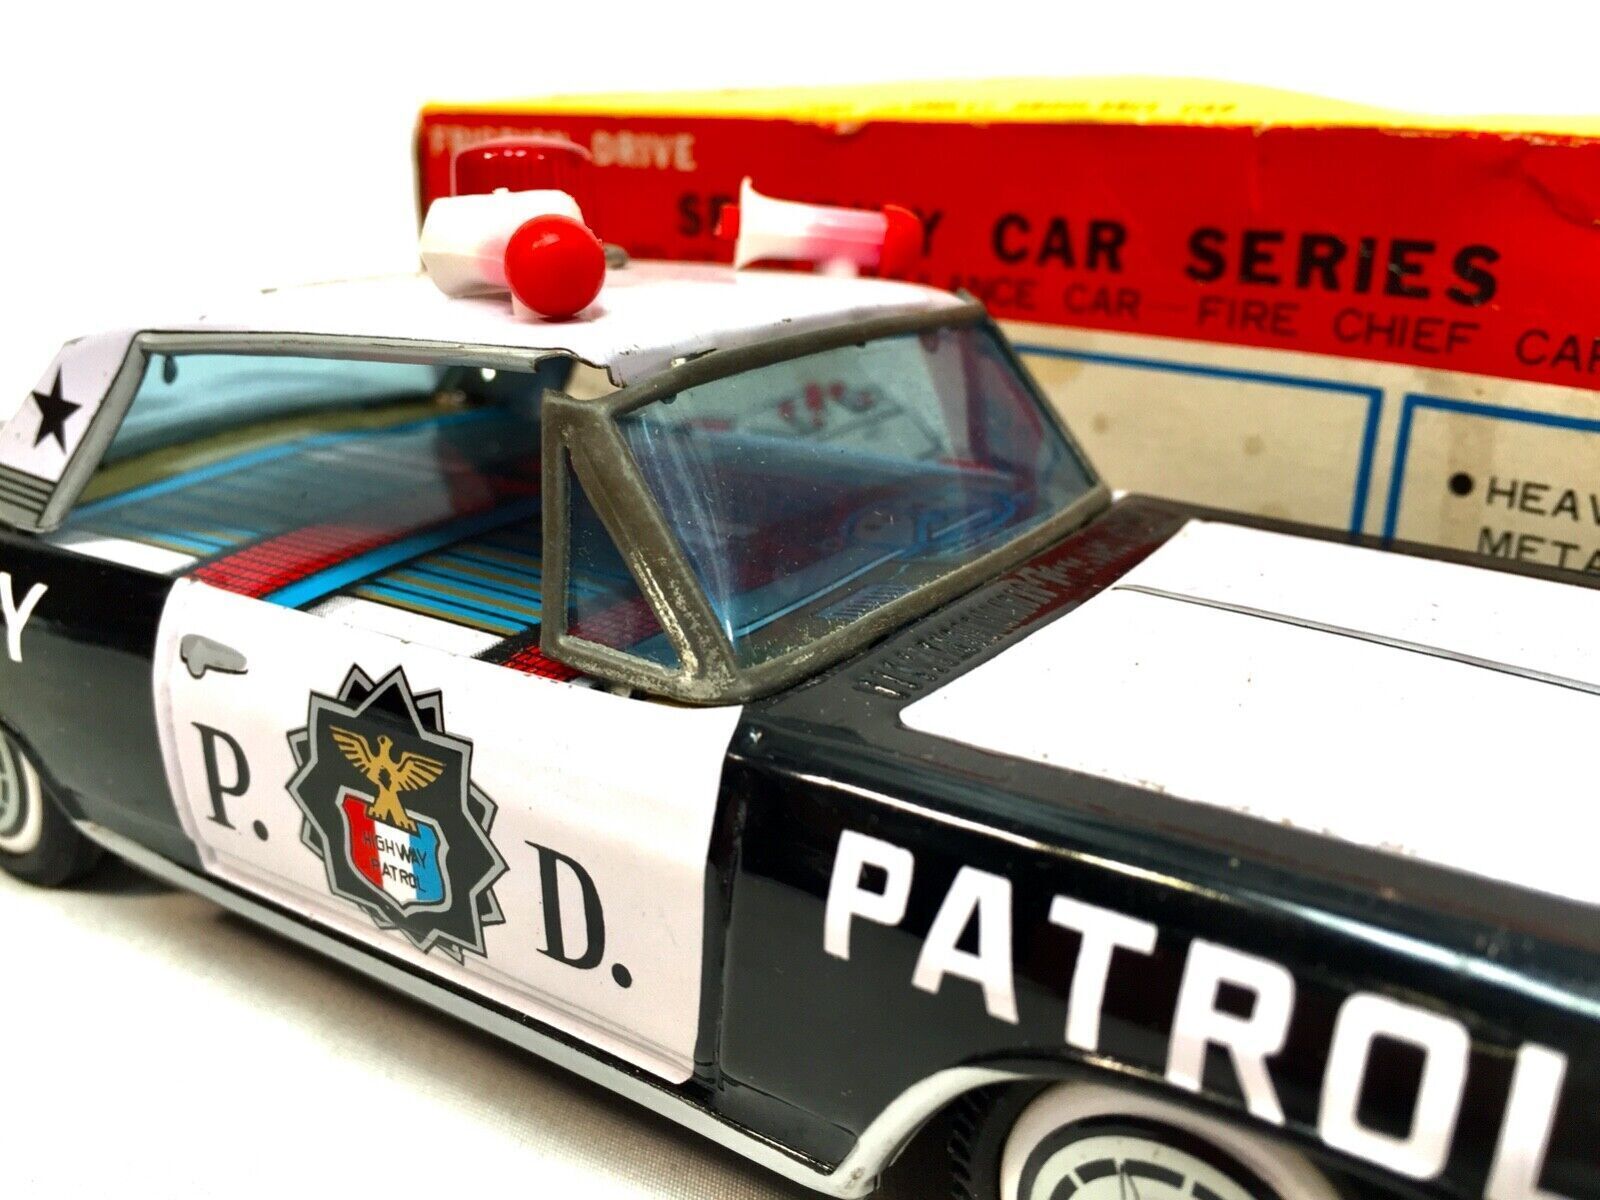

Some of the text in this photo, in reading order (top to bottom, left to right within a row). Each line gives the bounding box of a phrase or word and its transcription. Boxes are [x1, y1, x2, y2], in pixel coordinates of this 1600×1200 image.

[591, 128, 696, 172] DRIVE
[991, 213, 1127, 273] CAR
[1185, 226, 1501, 307] SERIES
[1063, 281, 1141, 320] CAR
[1195, 295, 1299, 338] FIRE
[1332, 306, 1481, 355] CHIEF
[191, 721, 633, 989] P. D.
[363, 831, 428, 869] HIGHWAY
[371, 857, 427, 893] PATROL
[823, 829, 1577, 1200] PATROL
